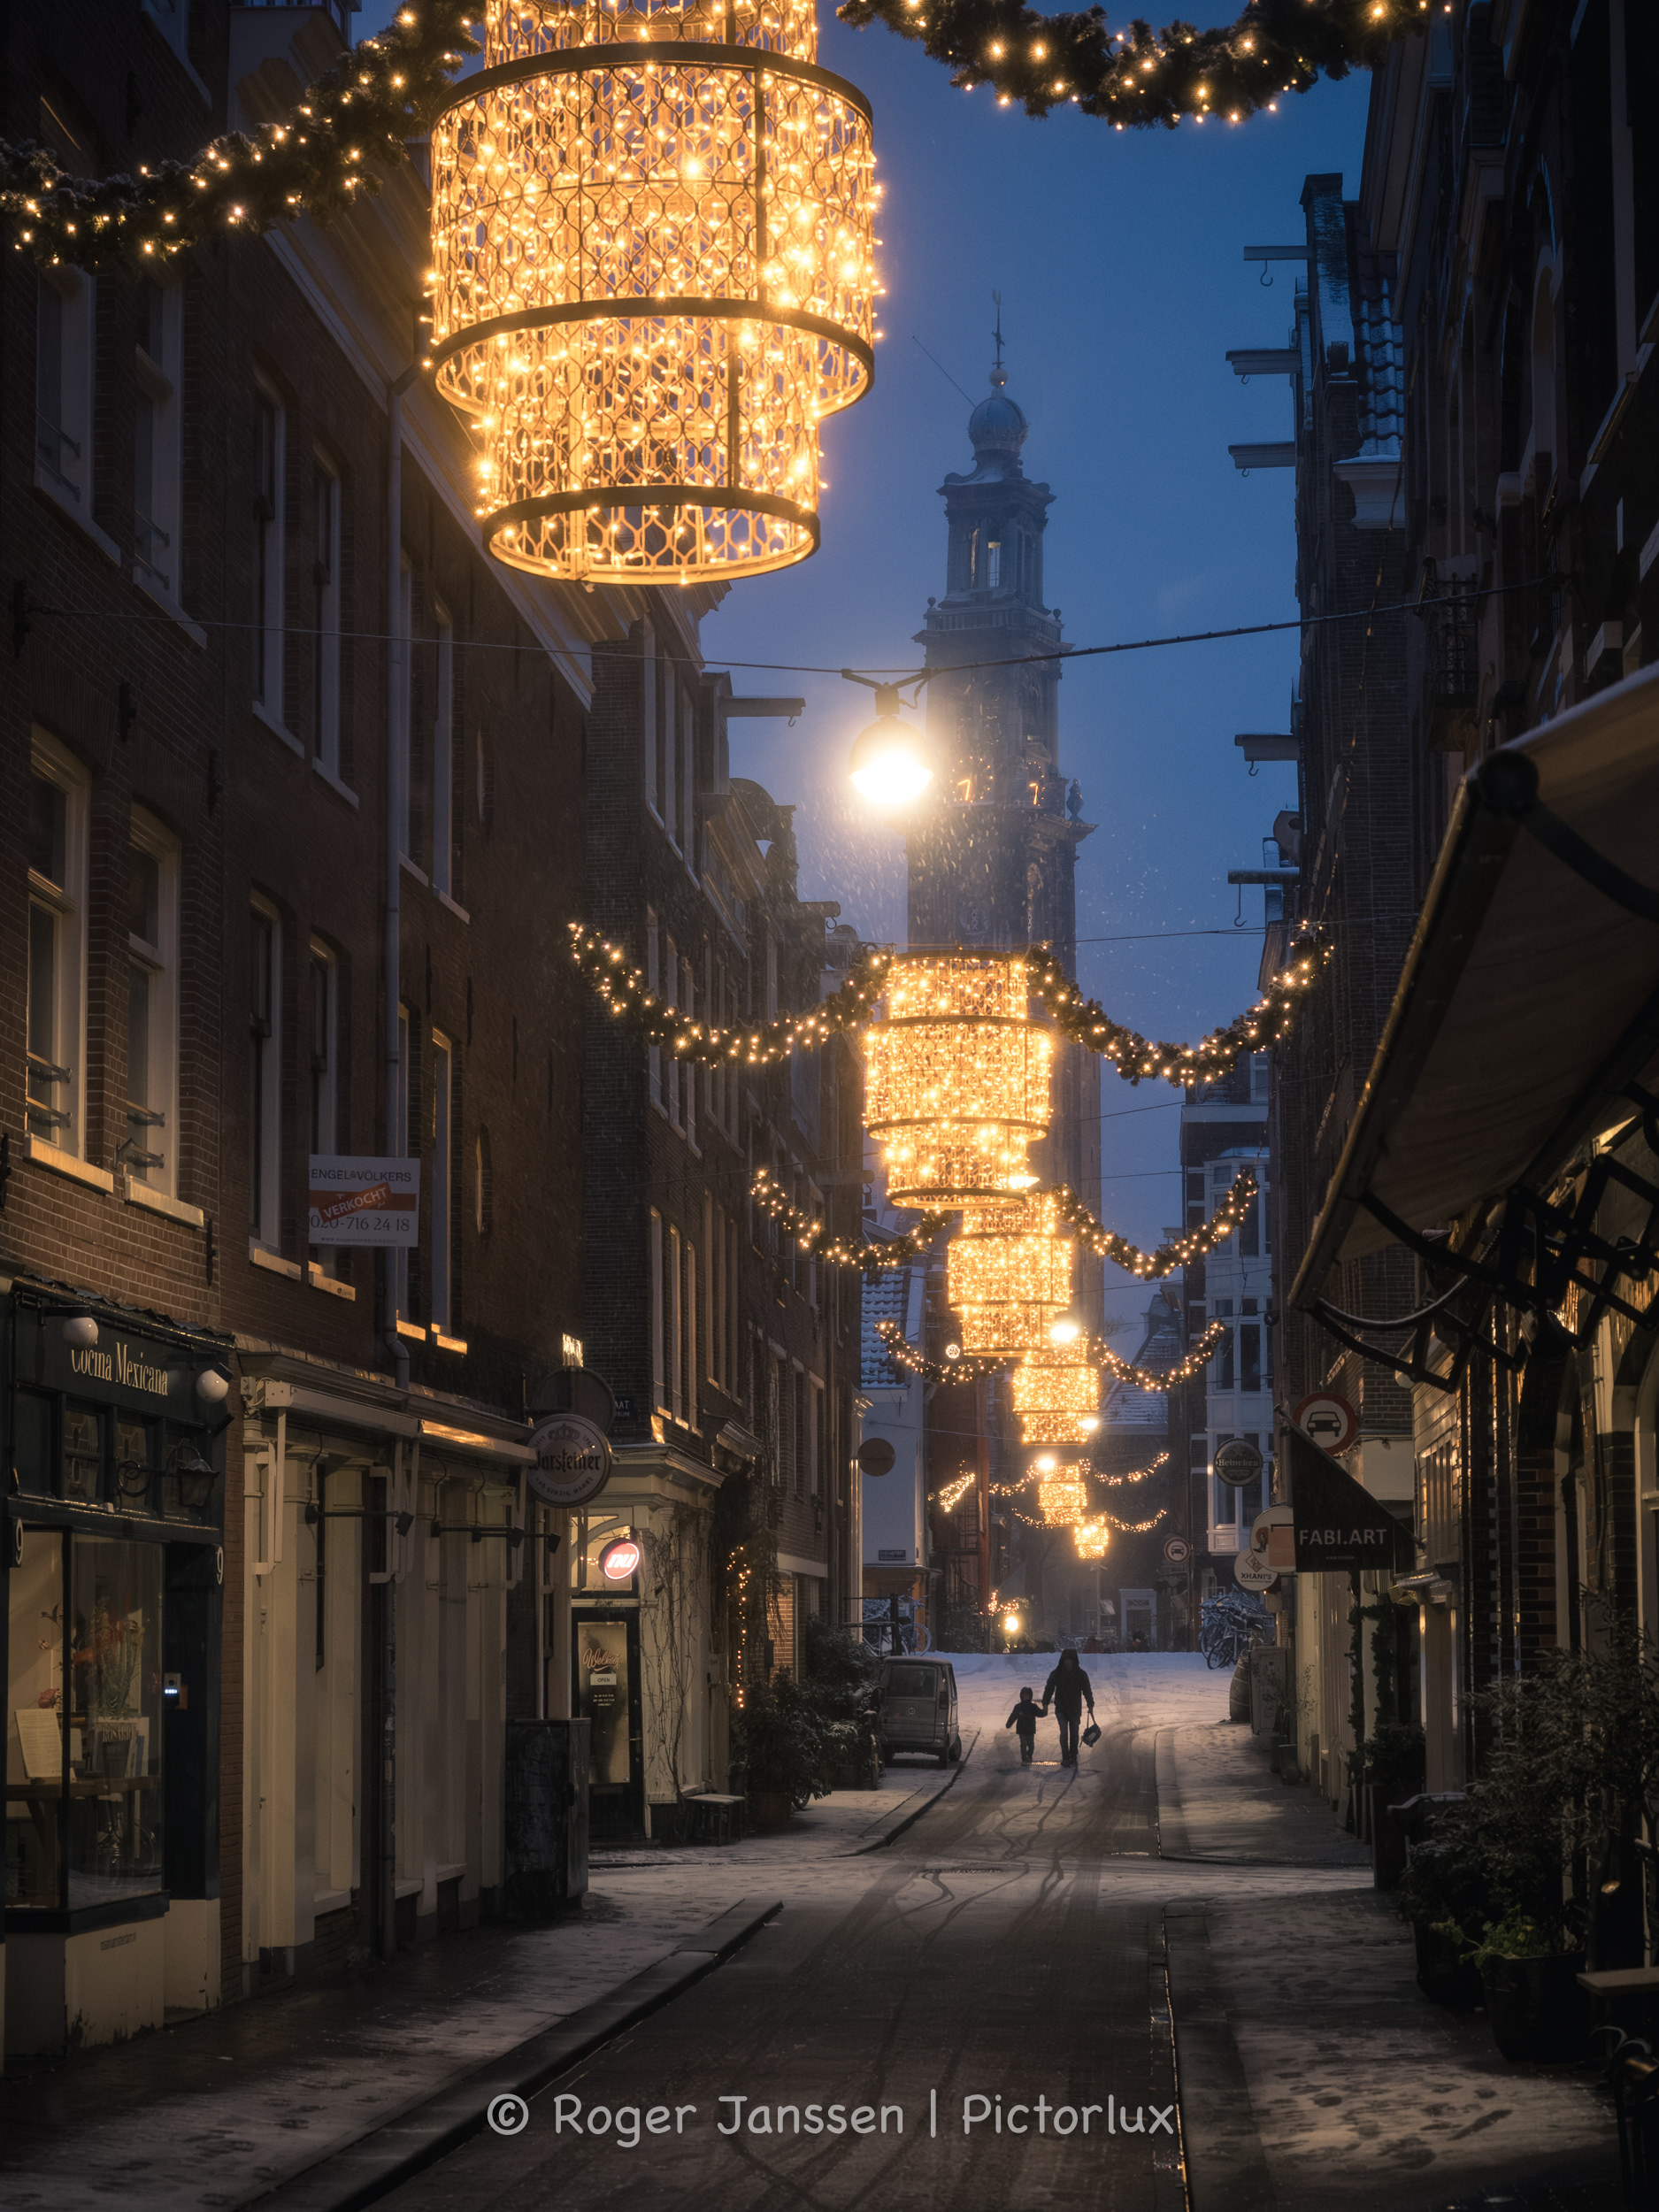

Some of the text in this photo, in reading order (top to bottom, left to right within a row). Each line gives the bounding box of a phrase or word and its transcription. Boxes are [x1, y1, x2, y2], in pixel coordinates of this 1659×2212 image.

[311, 1168, 411, 1182] ENGEL&VÖLKERS
[322, 1187, 388, 1218] VERKOCHT
[373, 1217, 390, 1231] 24
[396, 1217, 410, 1232] 18
[71, 1339, 168, 1396] Cocina Mexicana
[1217, 1458, 1258, 1467] Heineken
[15, 1518, 24, 1565] 9
[1299, 1528, 1387, 1546] FABI.ART
[216, 1547, 224, 1586] 9
[582, 1647, 622, 1671] Welkom
